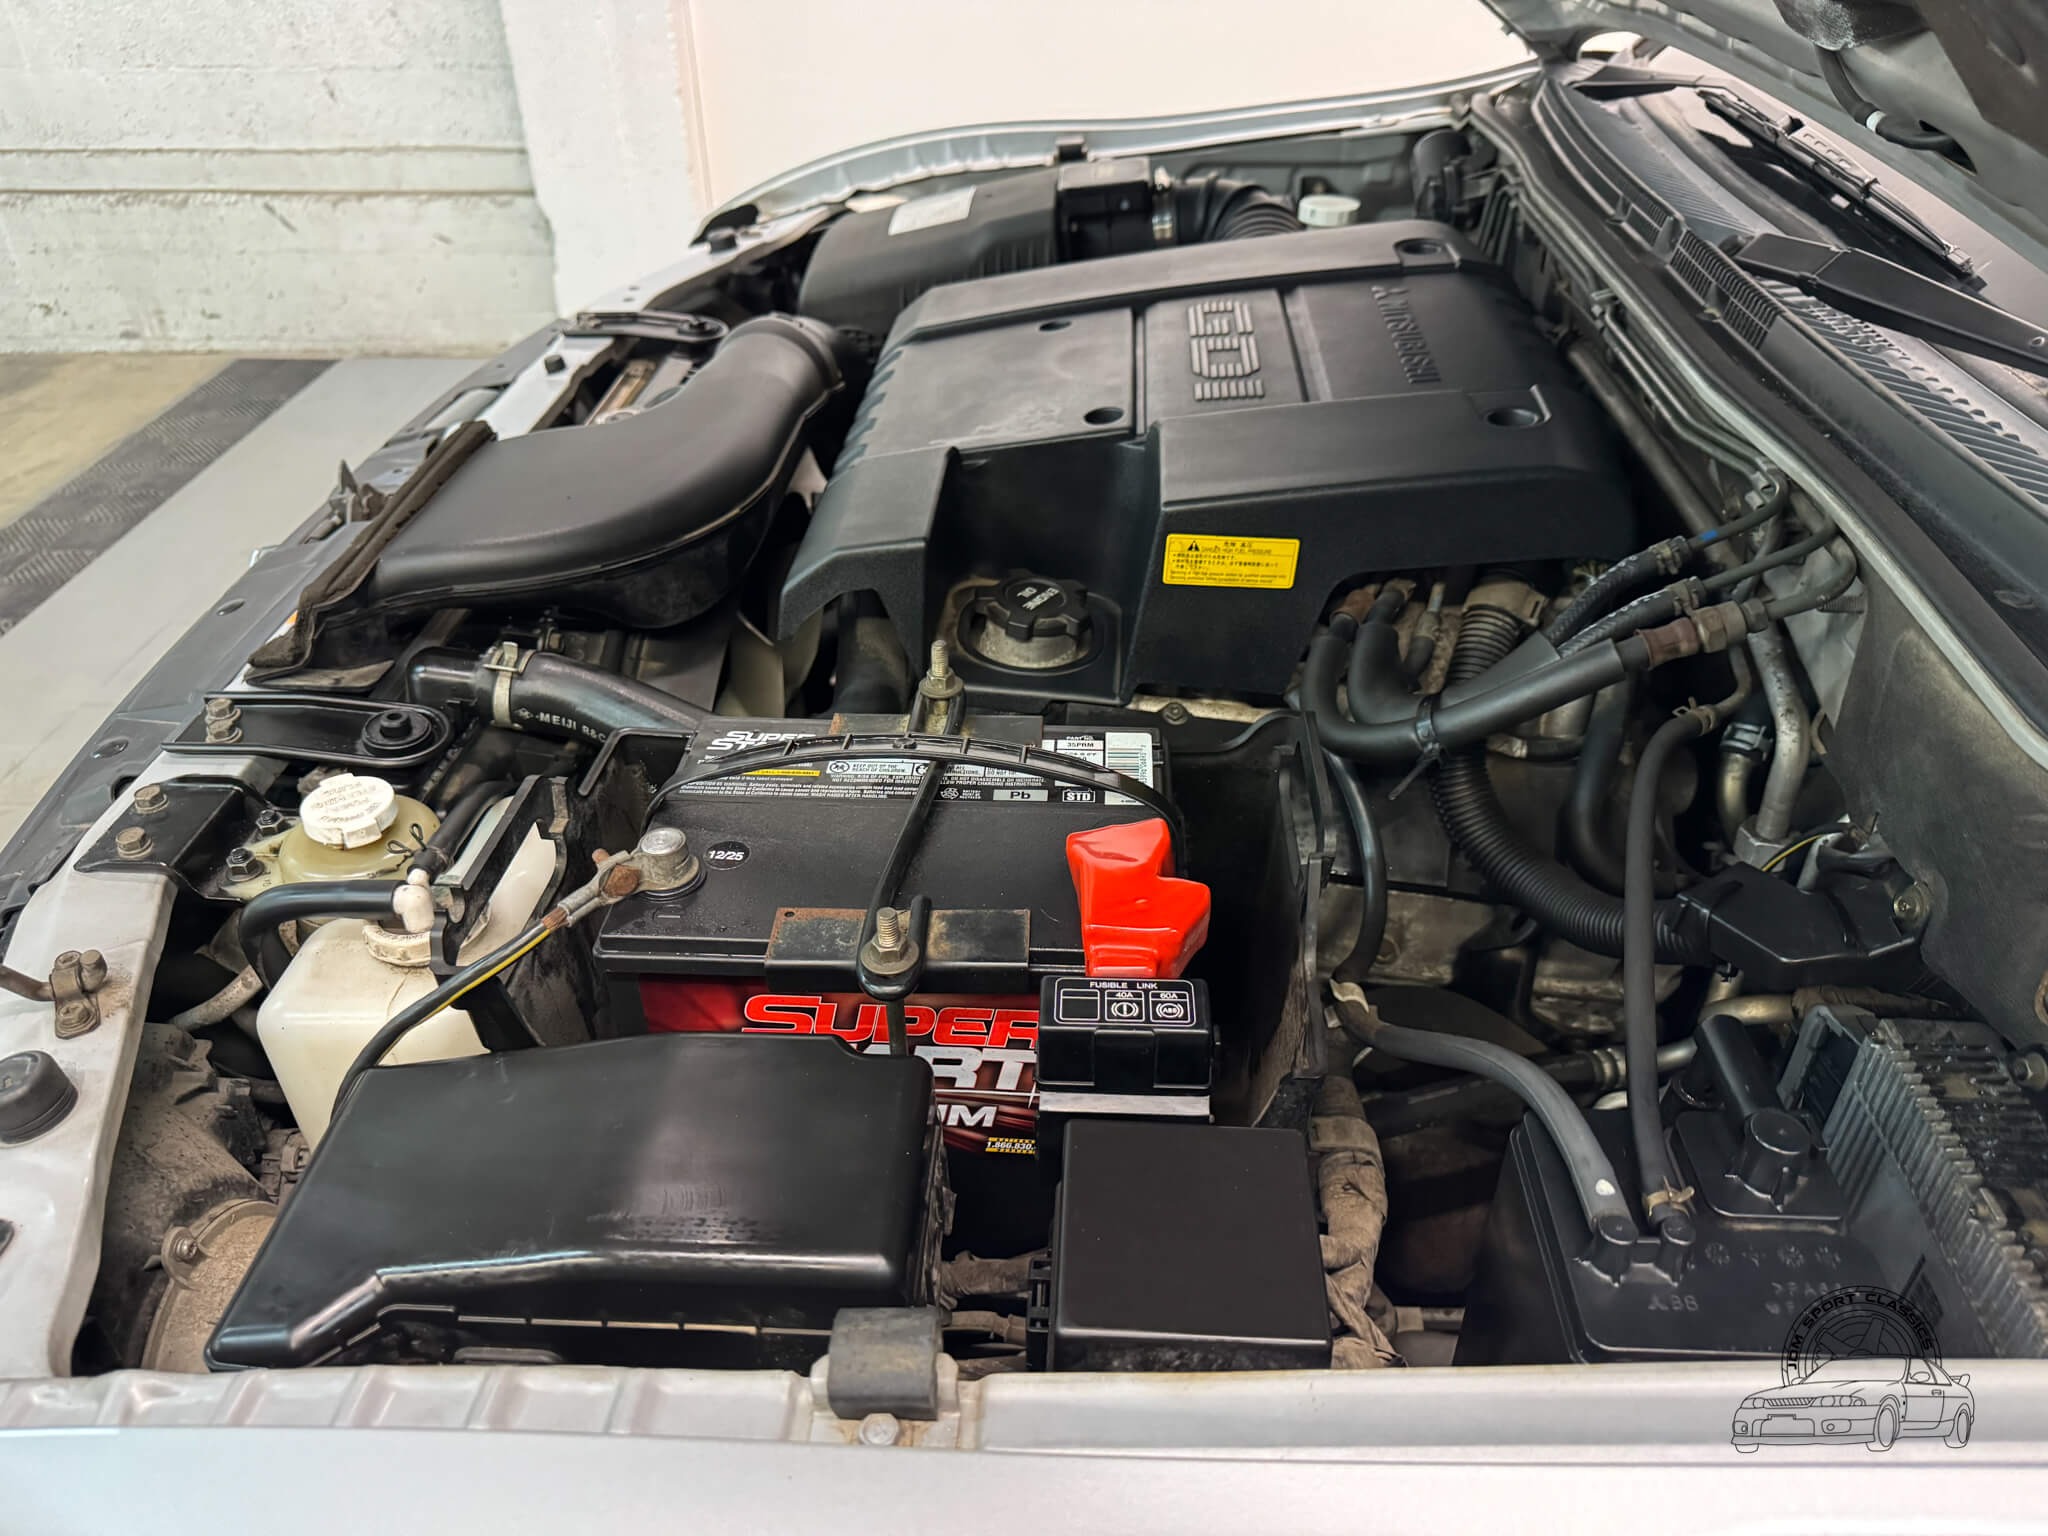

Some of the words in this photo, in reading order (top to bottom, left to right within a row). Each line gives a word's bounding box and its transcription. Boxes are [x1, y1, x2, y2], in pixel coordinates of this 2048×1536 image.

[540, 711, 576, 730] MEIJI
[1010, 791, 1031, 799] Pb
[1066, 792, 1091, 801] STD
[709, 850, 745, 861] 12/25
[1089, 981, 1128, 990] FUSIBLE
[1136, 982, 1158, 990] LINK
[742, 994, 1040, 1048] SUPER
